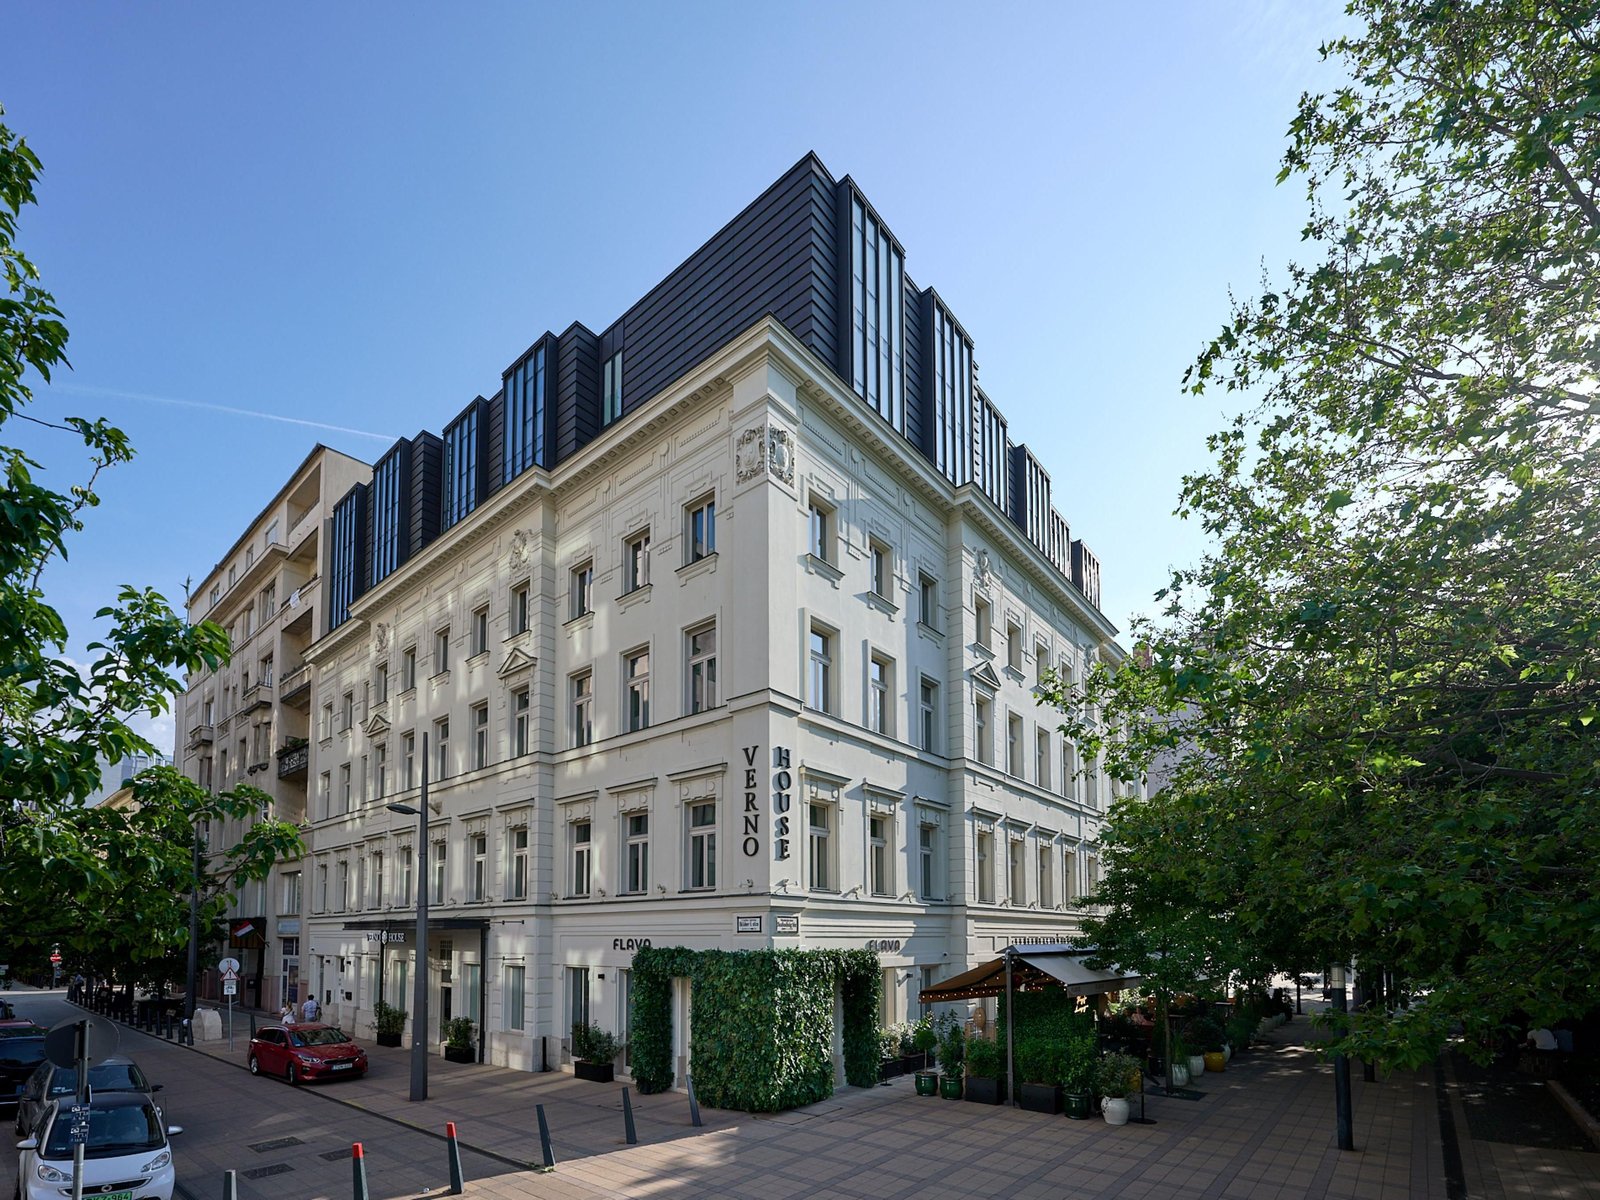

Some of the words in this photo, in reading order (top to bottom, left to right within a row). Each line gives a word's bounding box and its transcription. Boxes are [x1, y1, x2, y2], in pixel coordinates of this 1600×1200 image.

[742, 745, 760, 858] VERNO
[777, 745, 792, 860] HOUSE
[868, 939, 901, 952] FLAVA
